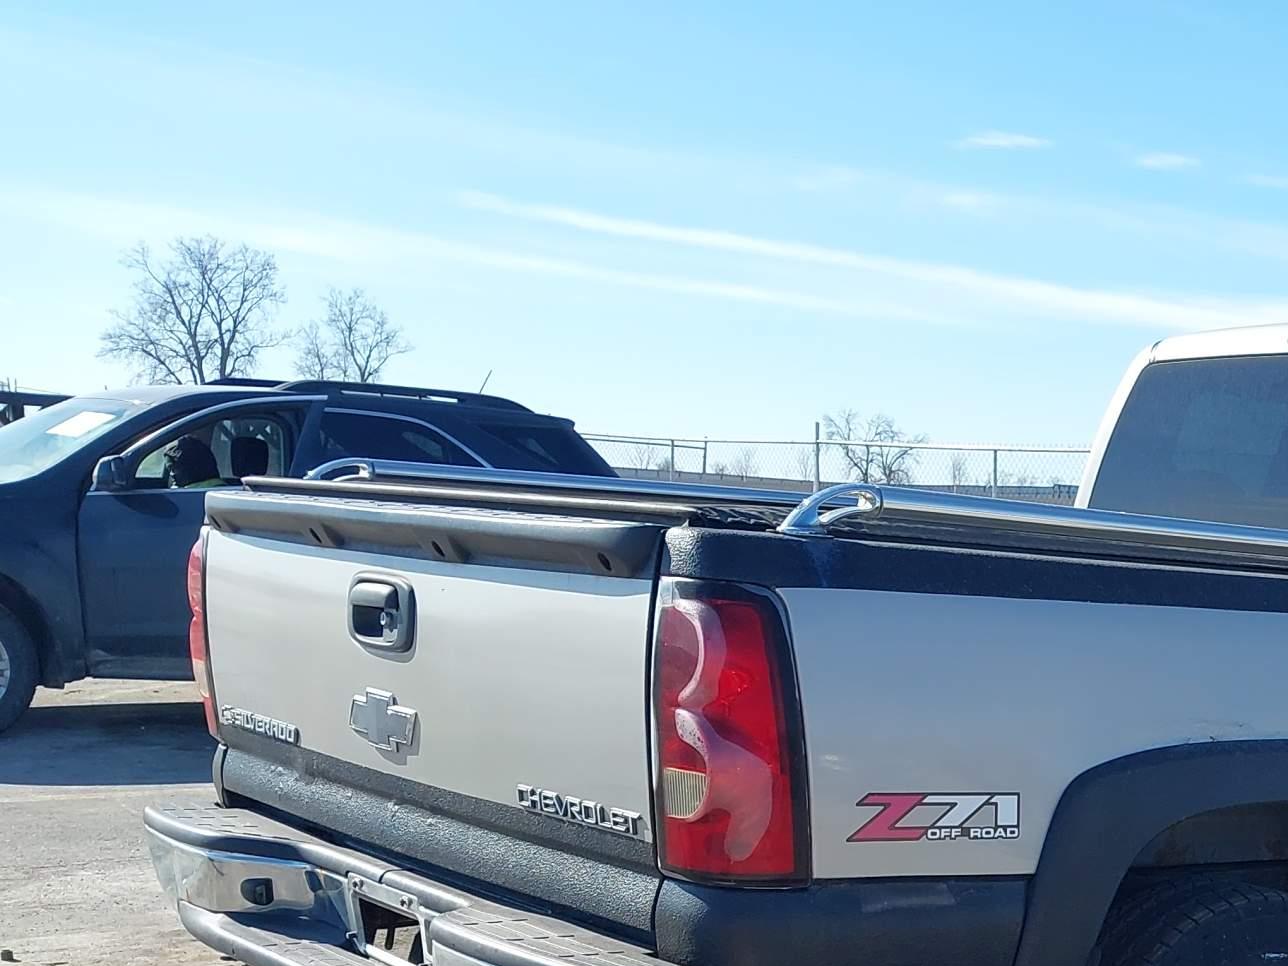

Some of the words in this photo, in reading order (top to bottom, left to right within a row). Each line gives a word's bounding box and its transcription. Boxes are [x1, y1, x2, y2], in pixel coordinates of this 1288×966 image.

[222, 704, 297, 743] SILVERADO
[516, 784, 640, 835] CHEVROLET
[846, 792, 1020, 842] Z71
[926, 827, 962, 840] OFF
[969, 826, 1019, 839] ROAD
